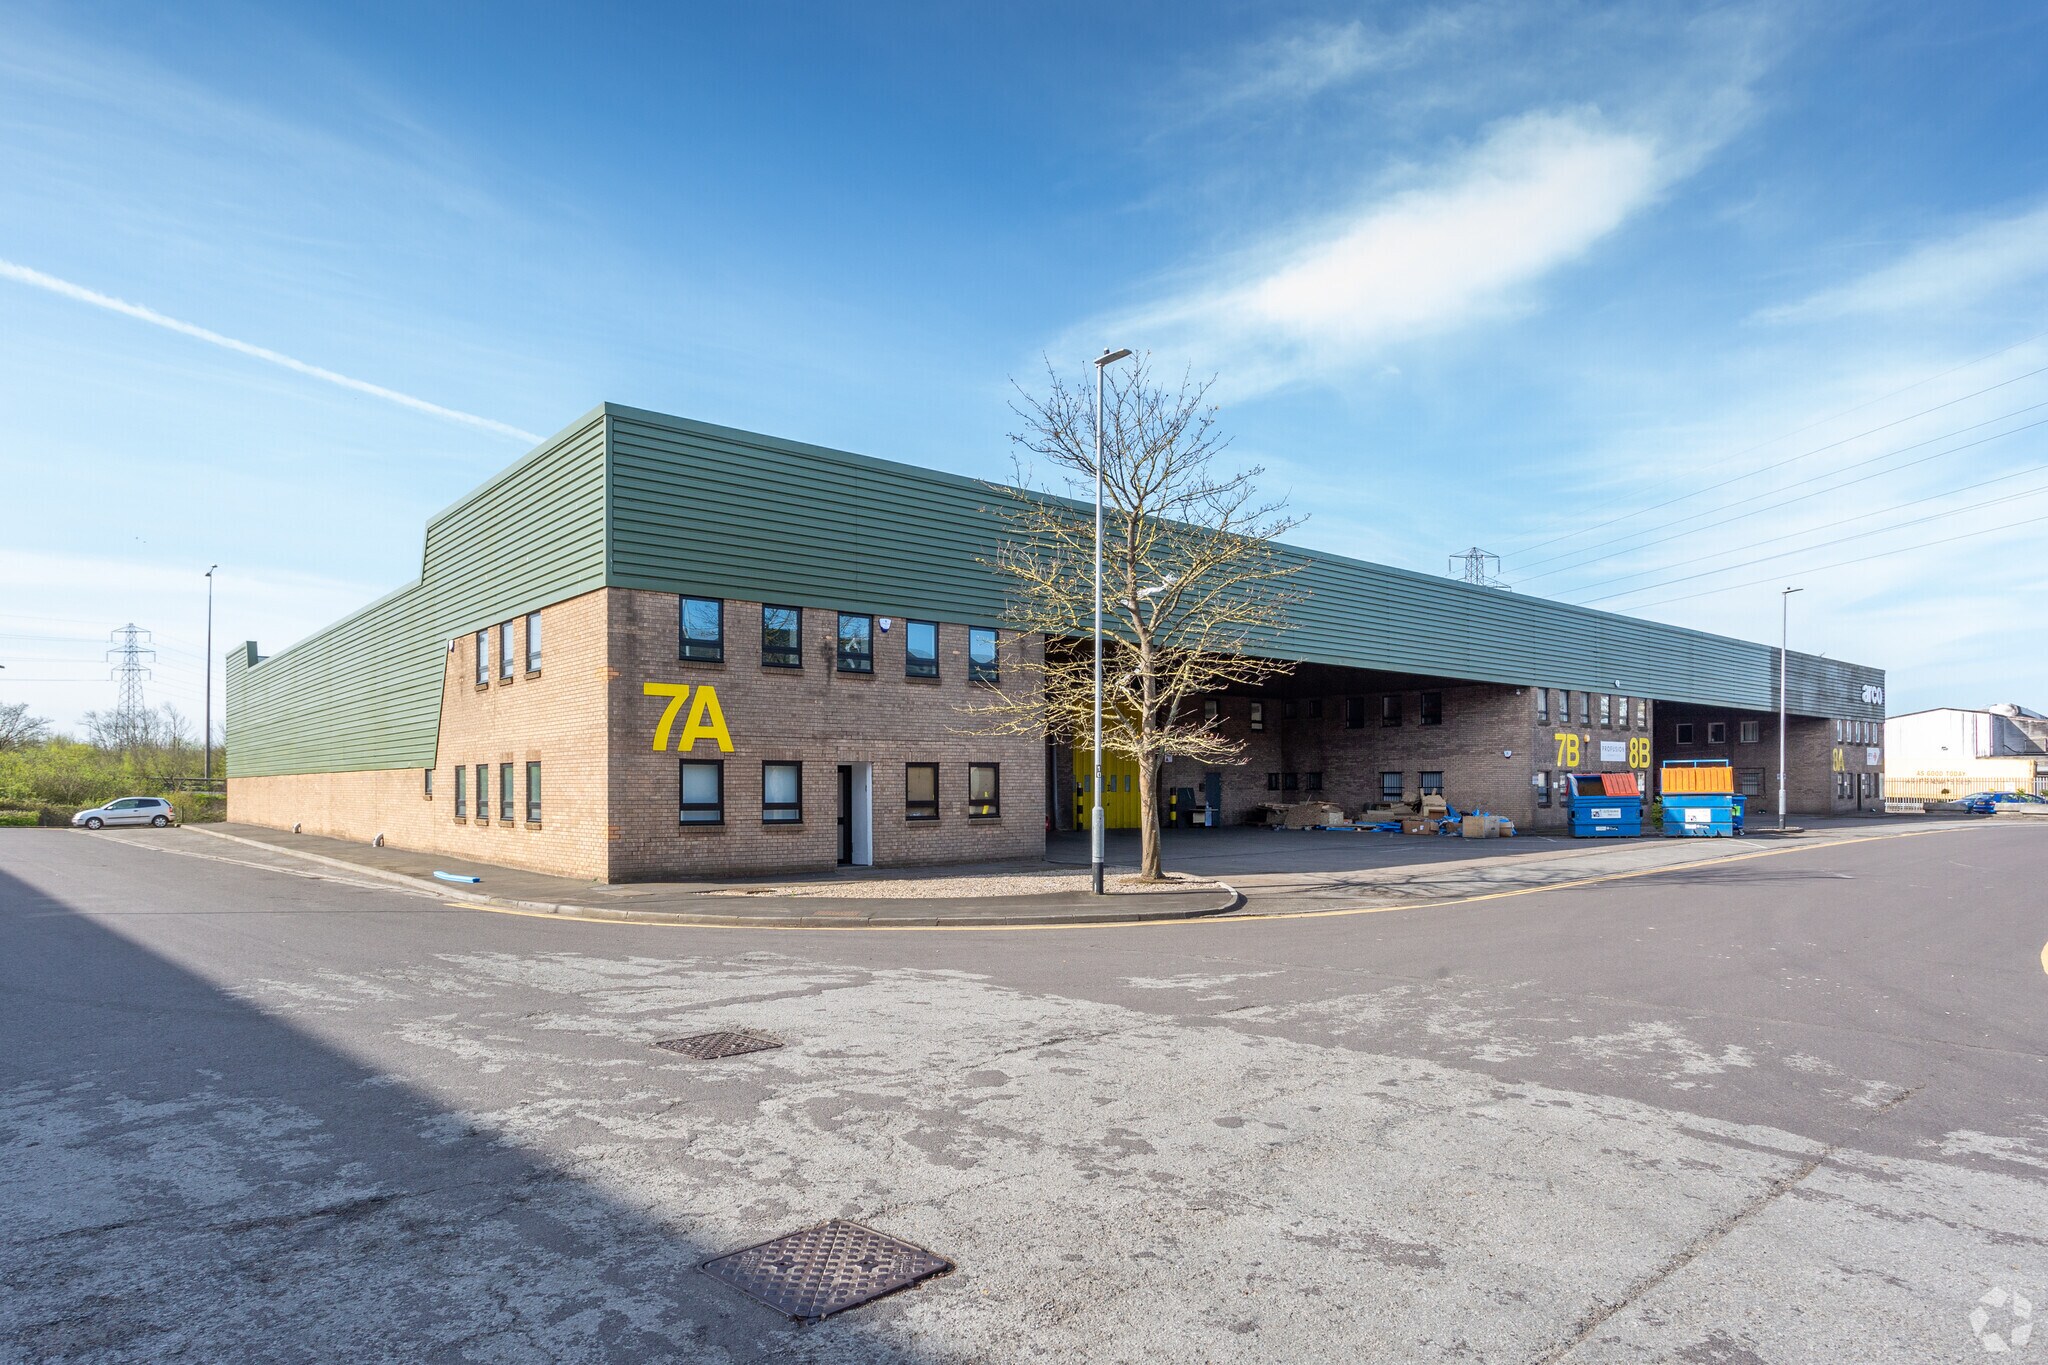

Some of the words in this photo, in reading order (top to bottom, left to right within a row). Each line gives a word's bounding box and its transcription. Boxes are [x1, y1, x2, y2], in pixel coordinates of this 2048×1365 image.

[1861, 684, 1882, 705] arco
[643, 682, 734, 752] 7A
[1554, 733, 1580, 767] 7B
[1629, 737, 1651, 769] 8B
[1832, 748, 1845, 772] 8A
